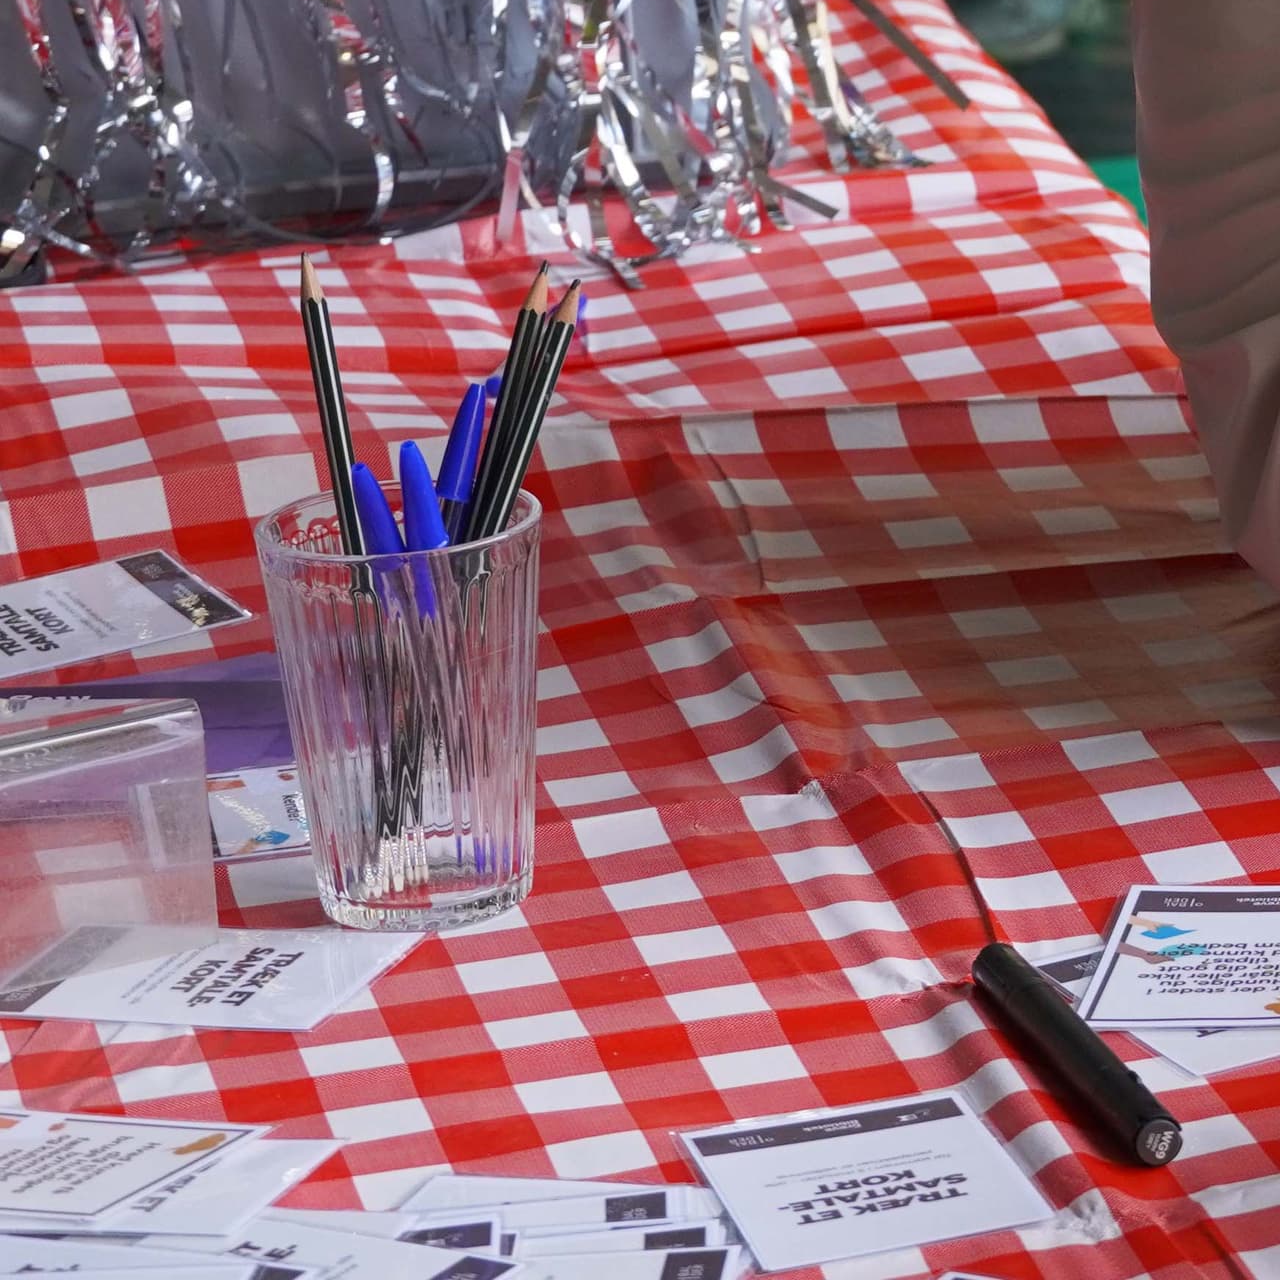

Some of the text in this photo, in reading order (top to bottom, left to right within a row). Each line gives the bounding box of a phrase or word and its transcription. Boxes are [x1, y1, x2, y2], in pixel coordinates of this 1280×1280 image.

[24, 607, 75, 635] KORT
[1176, 942, 1247, 950] bedre?
[239, 951, 304, 989] TRÆK
[1158, 964, 1208, 972] godt
[1201, 956, 1269, 965] tilpas?
[1215, 964, 1247, 972] dig
[170, 959, 228, 993] KORT
[186, 947, 275, 1007] SAMTALE-
[1188, 972, 1233, 980] eller
[221, 990, 255, 1007] ET
[1155, 1131, 1174, 1159] WG9
[778, 1172, 968, 1212] SAMTALE-
[815, 1170, 915, 1195] KORT
[797, 1187, 968, 1225] TRÆK ET
